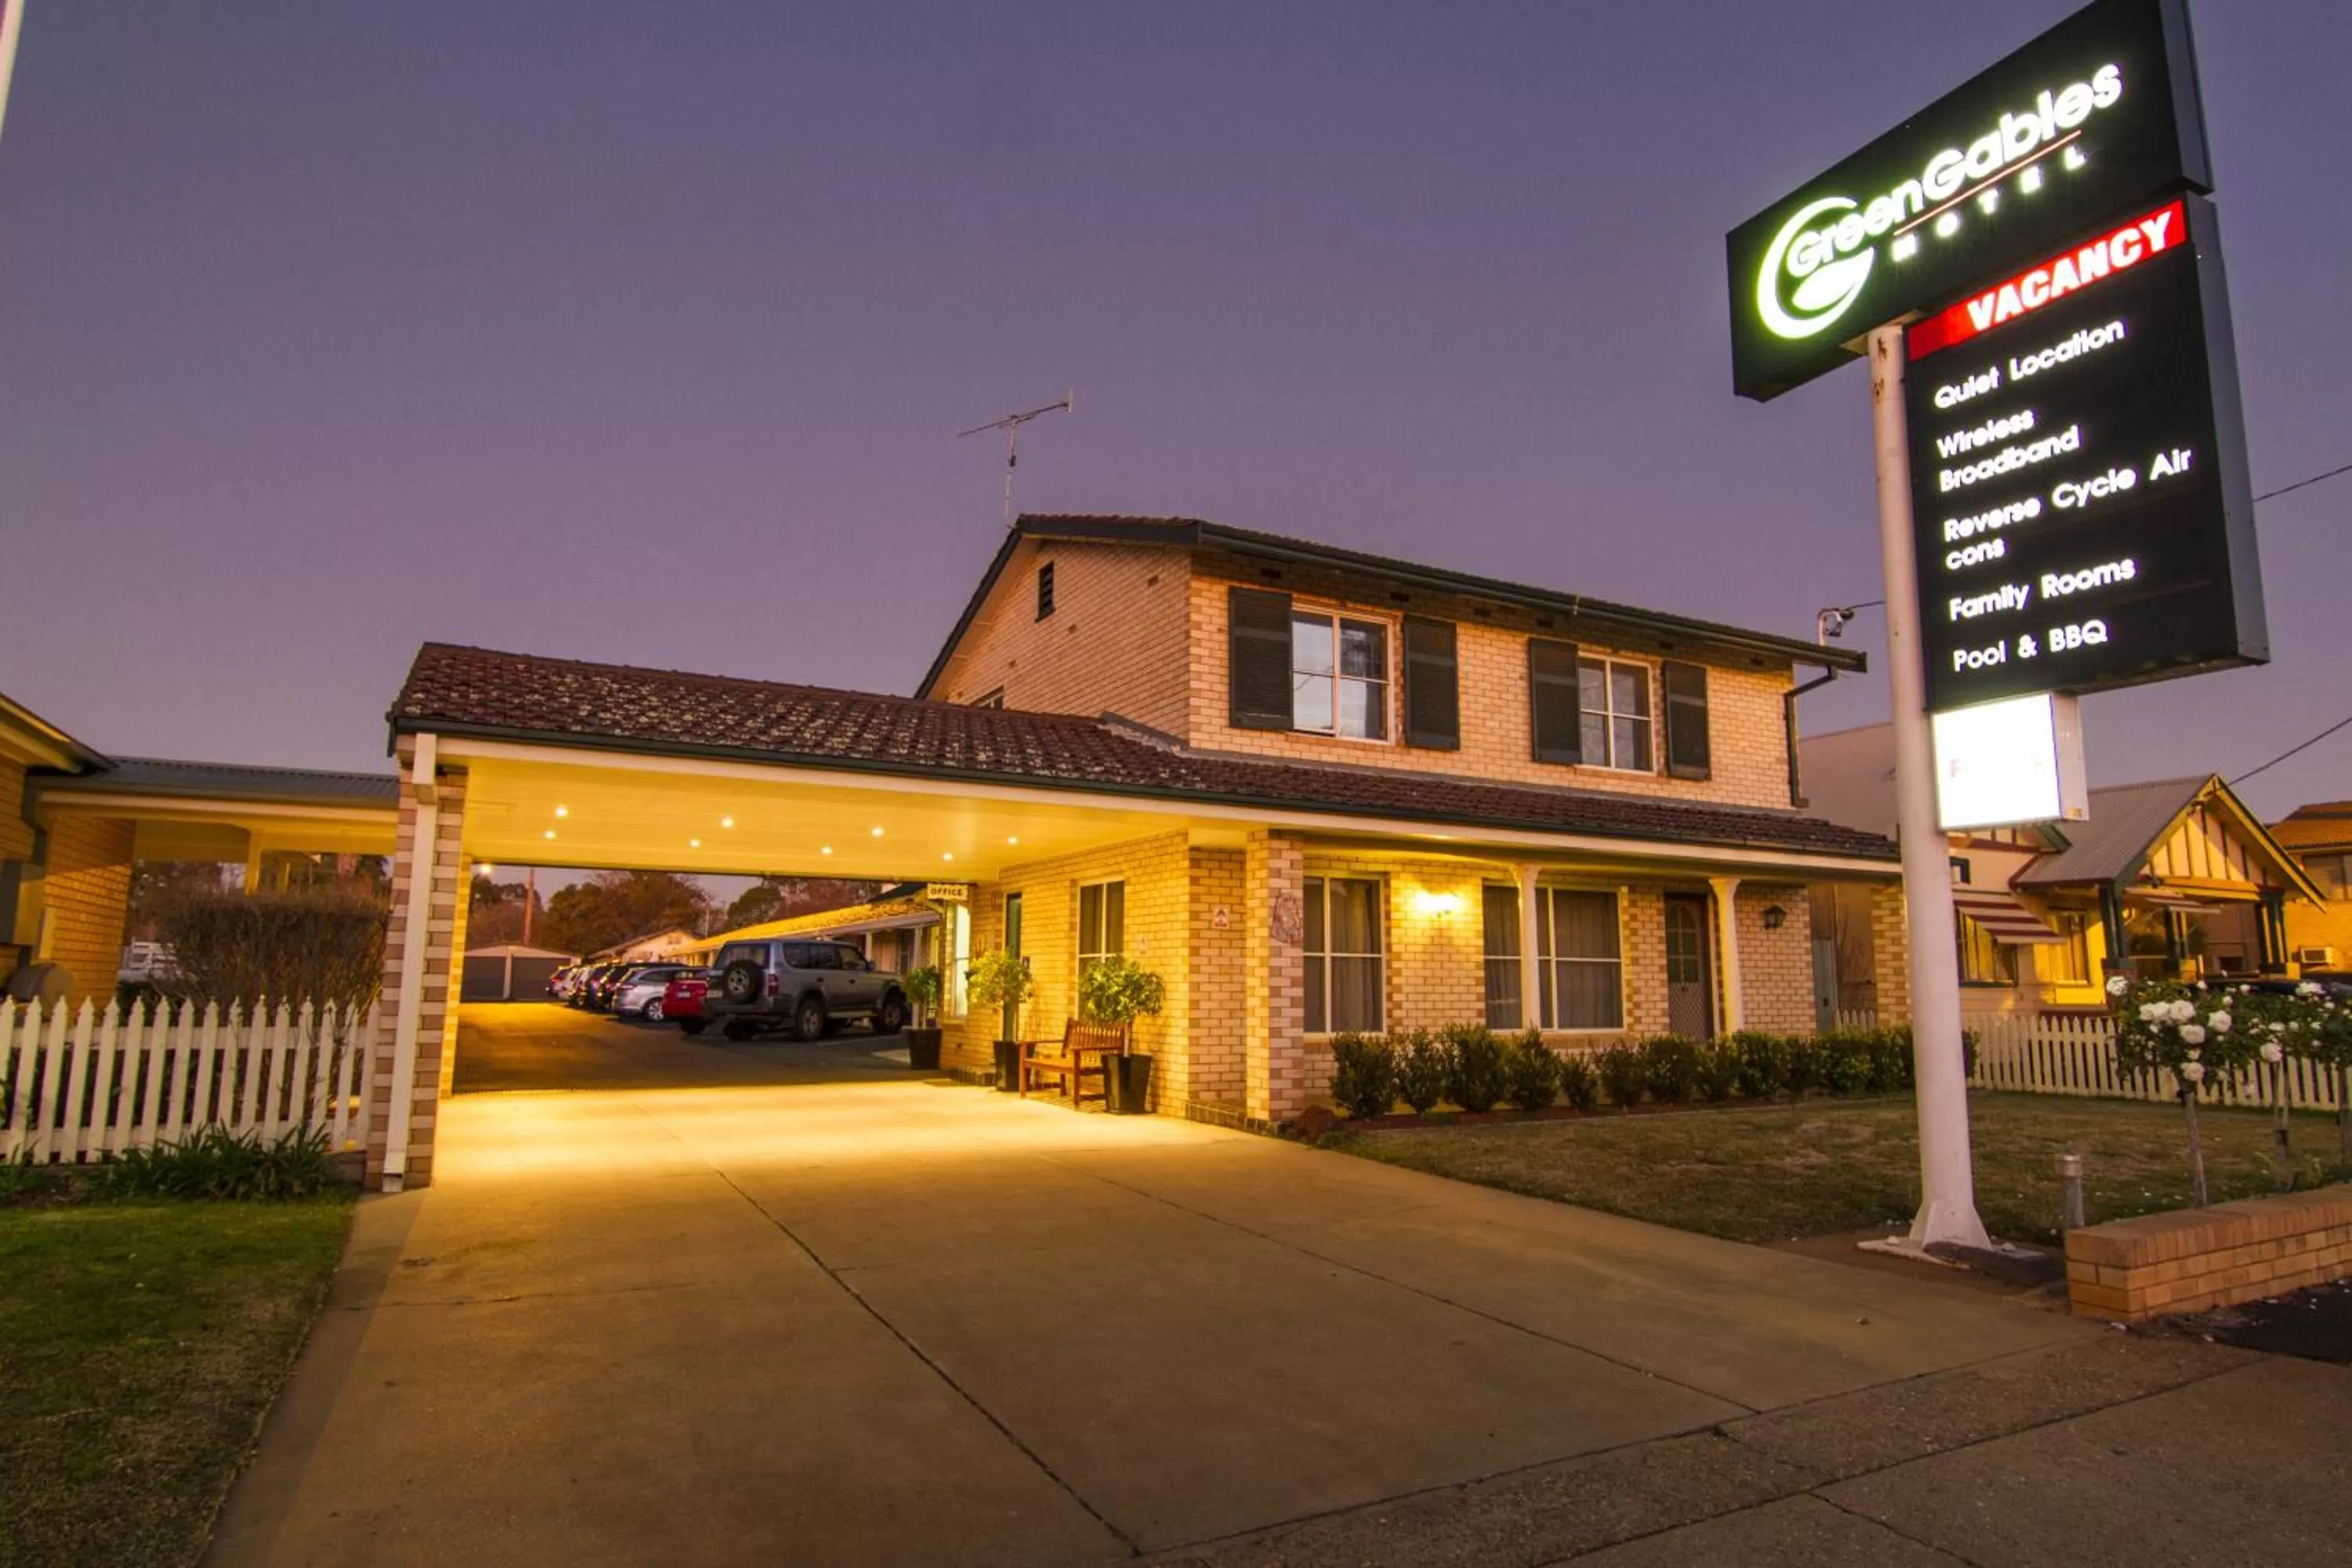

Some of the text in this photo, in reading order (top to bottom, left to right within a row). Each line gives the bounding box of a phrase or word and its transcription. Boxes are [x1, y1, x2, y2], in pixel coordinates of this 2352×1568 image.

[1785, 63, 2123, 279] GreenGables
[1890, 144, 2086, 263] MOTEL
[1966, 211, 2172, 331] VACANCY
[1934, 321, 2125, 408] Quiet Location
[1936, 409, 2034, 459] Wireless
[1940, 424, 2080, 492] Broadband
[1944, 448, 2191, 543] Reverse Cycle Air
[1945, 538, 2005, 570] cons
[1949, 558, 2136, 622] Family Rooms
[1953, 619, 2108, 672] Pool & BBQ
[930, 887, 963, 897] OFFICE
